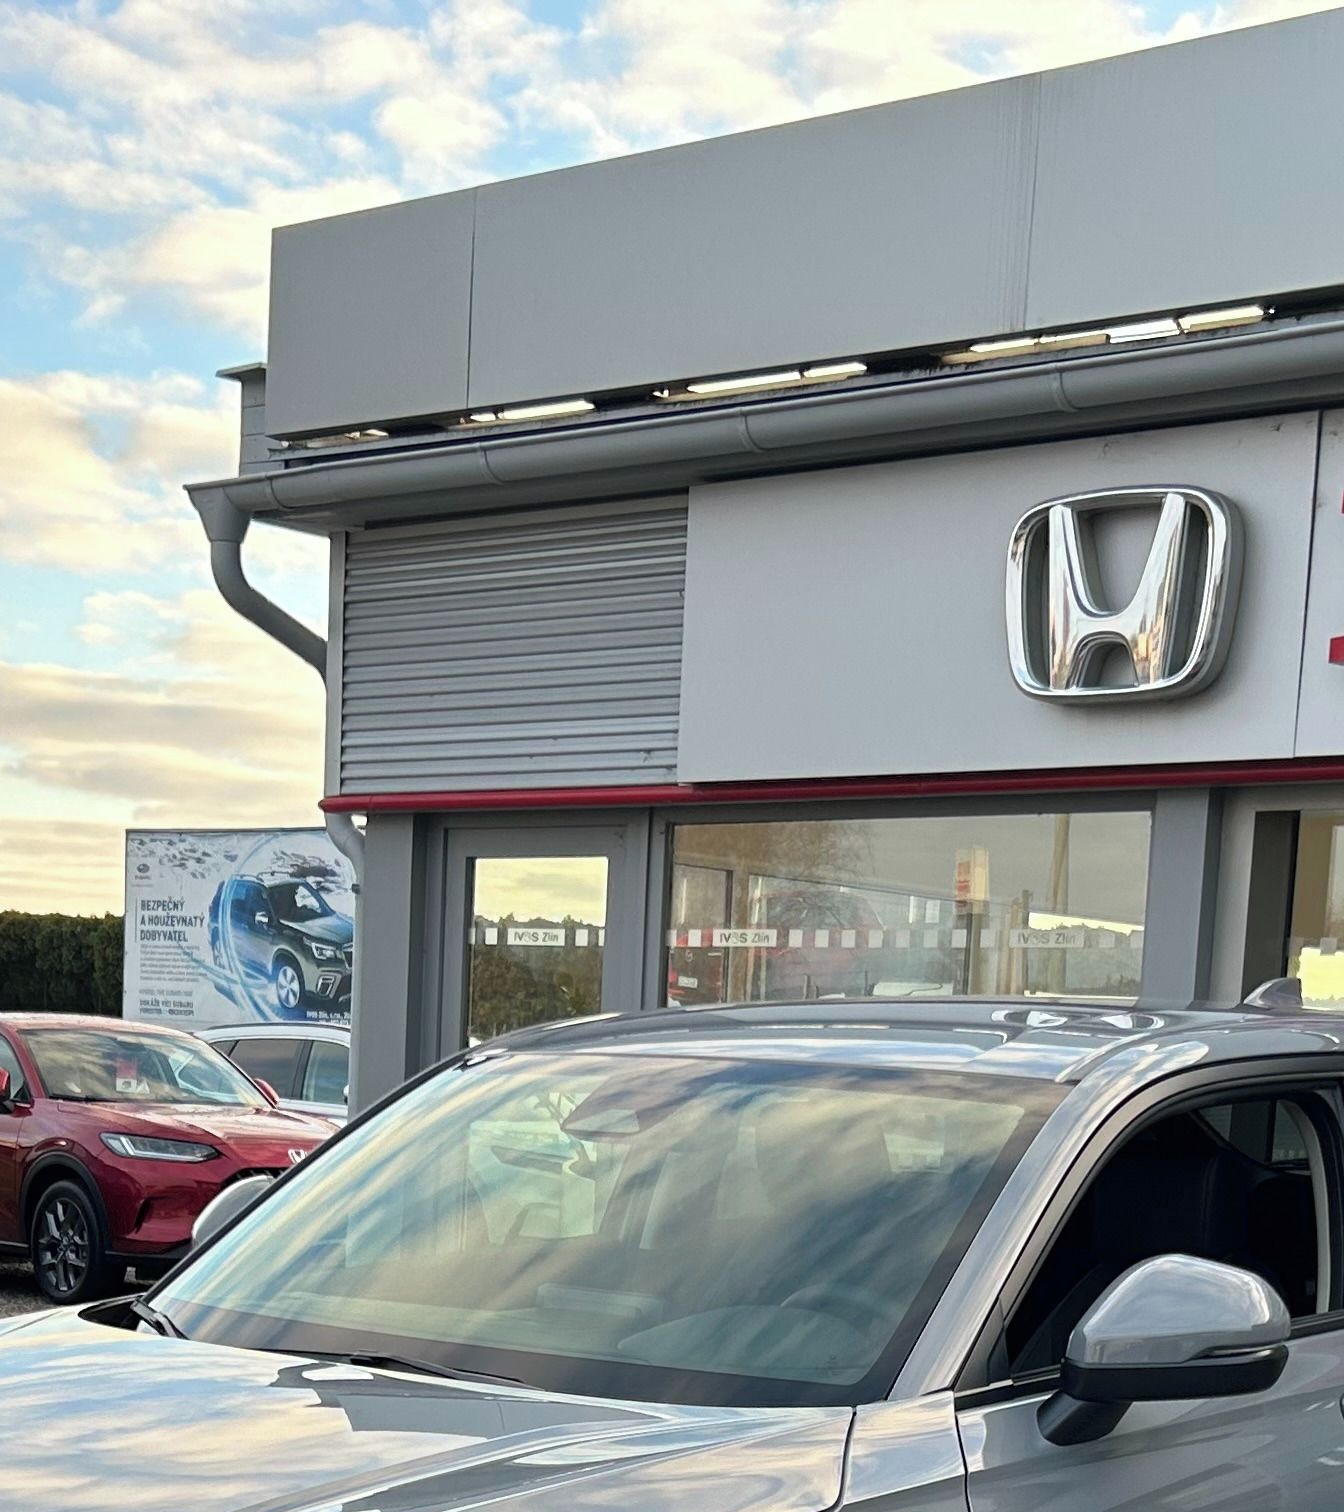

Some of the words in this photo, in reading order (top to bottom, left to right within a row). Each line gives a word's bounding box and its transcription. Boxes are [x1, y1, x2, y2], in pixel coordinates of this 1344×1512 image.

[140, 896, 185, 912] BEZPEČNÝ
[140, 916, 147, 926] A
[148, 912, 205, 928] HOUŽEVNATÝ
[140, 930, 189, 942] DOBYVATEL
